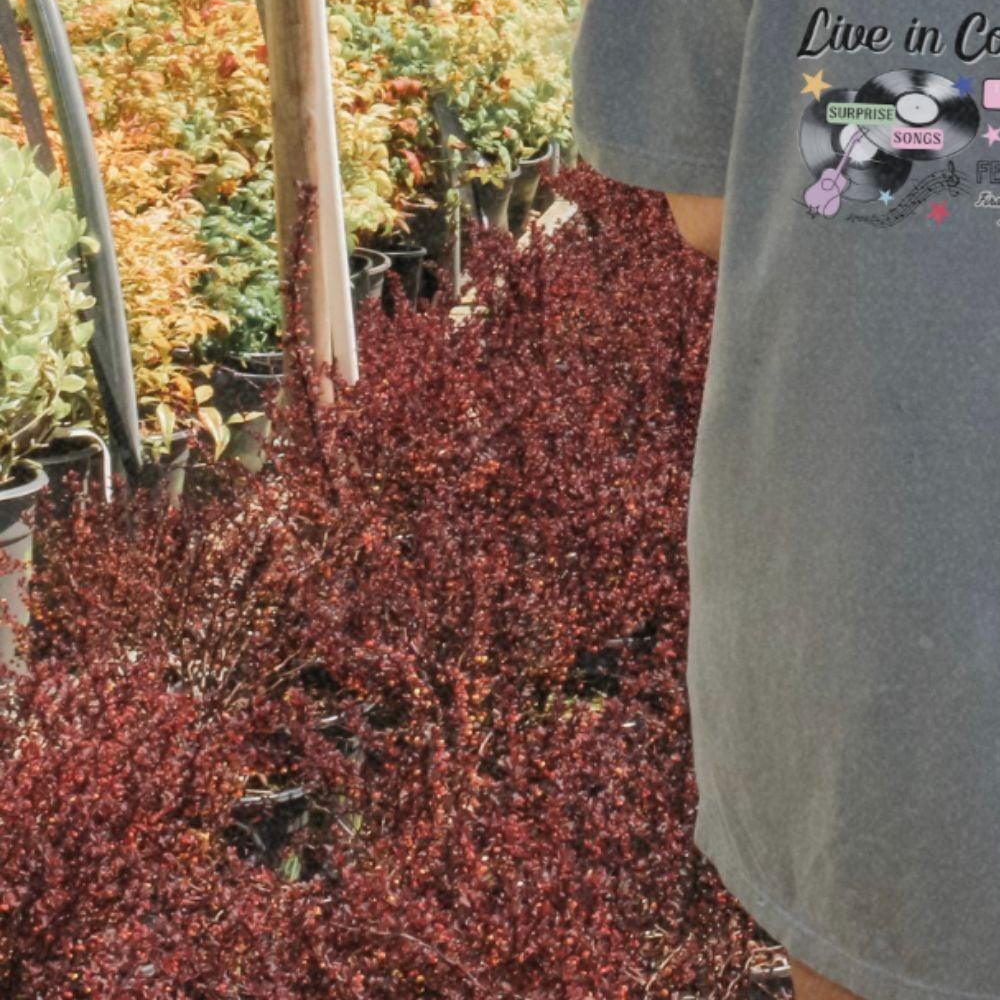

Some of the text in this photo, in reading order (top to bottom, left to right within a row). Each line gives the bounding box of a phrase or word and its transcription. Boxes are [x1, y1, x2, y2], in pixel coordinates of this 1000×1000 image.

[796, 6, 893, 58] Live
[904, 17, 945, 56] in
[828, 106, 895, 121] SURPRISE
[893, 131, 942, 145] SONGS
